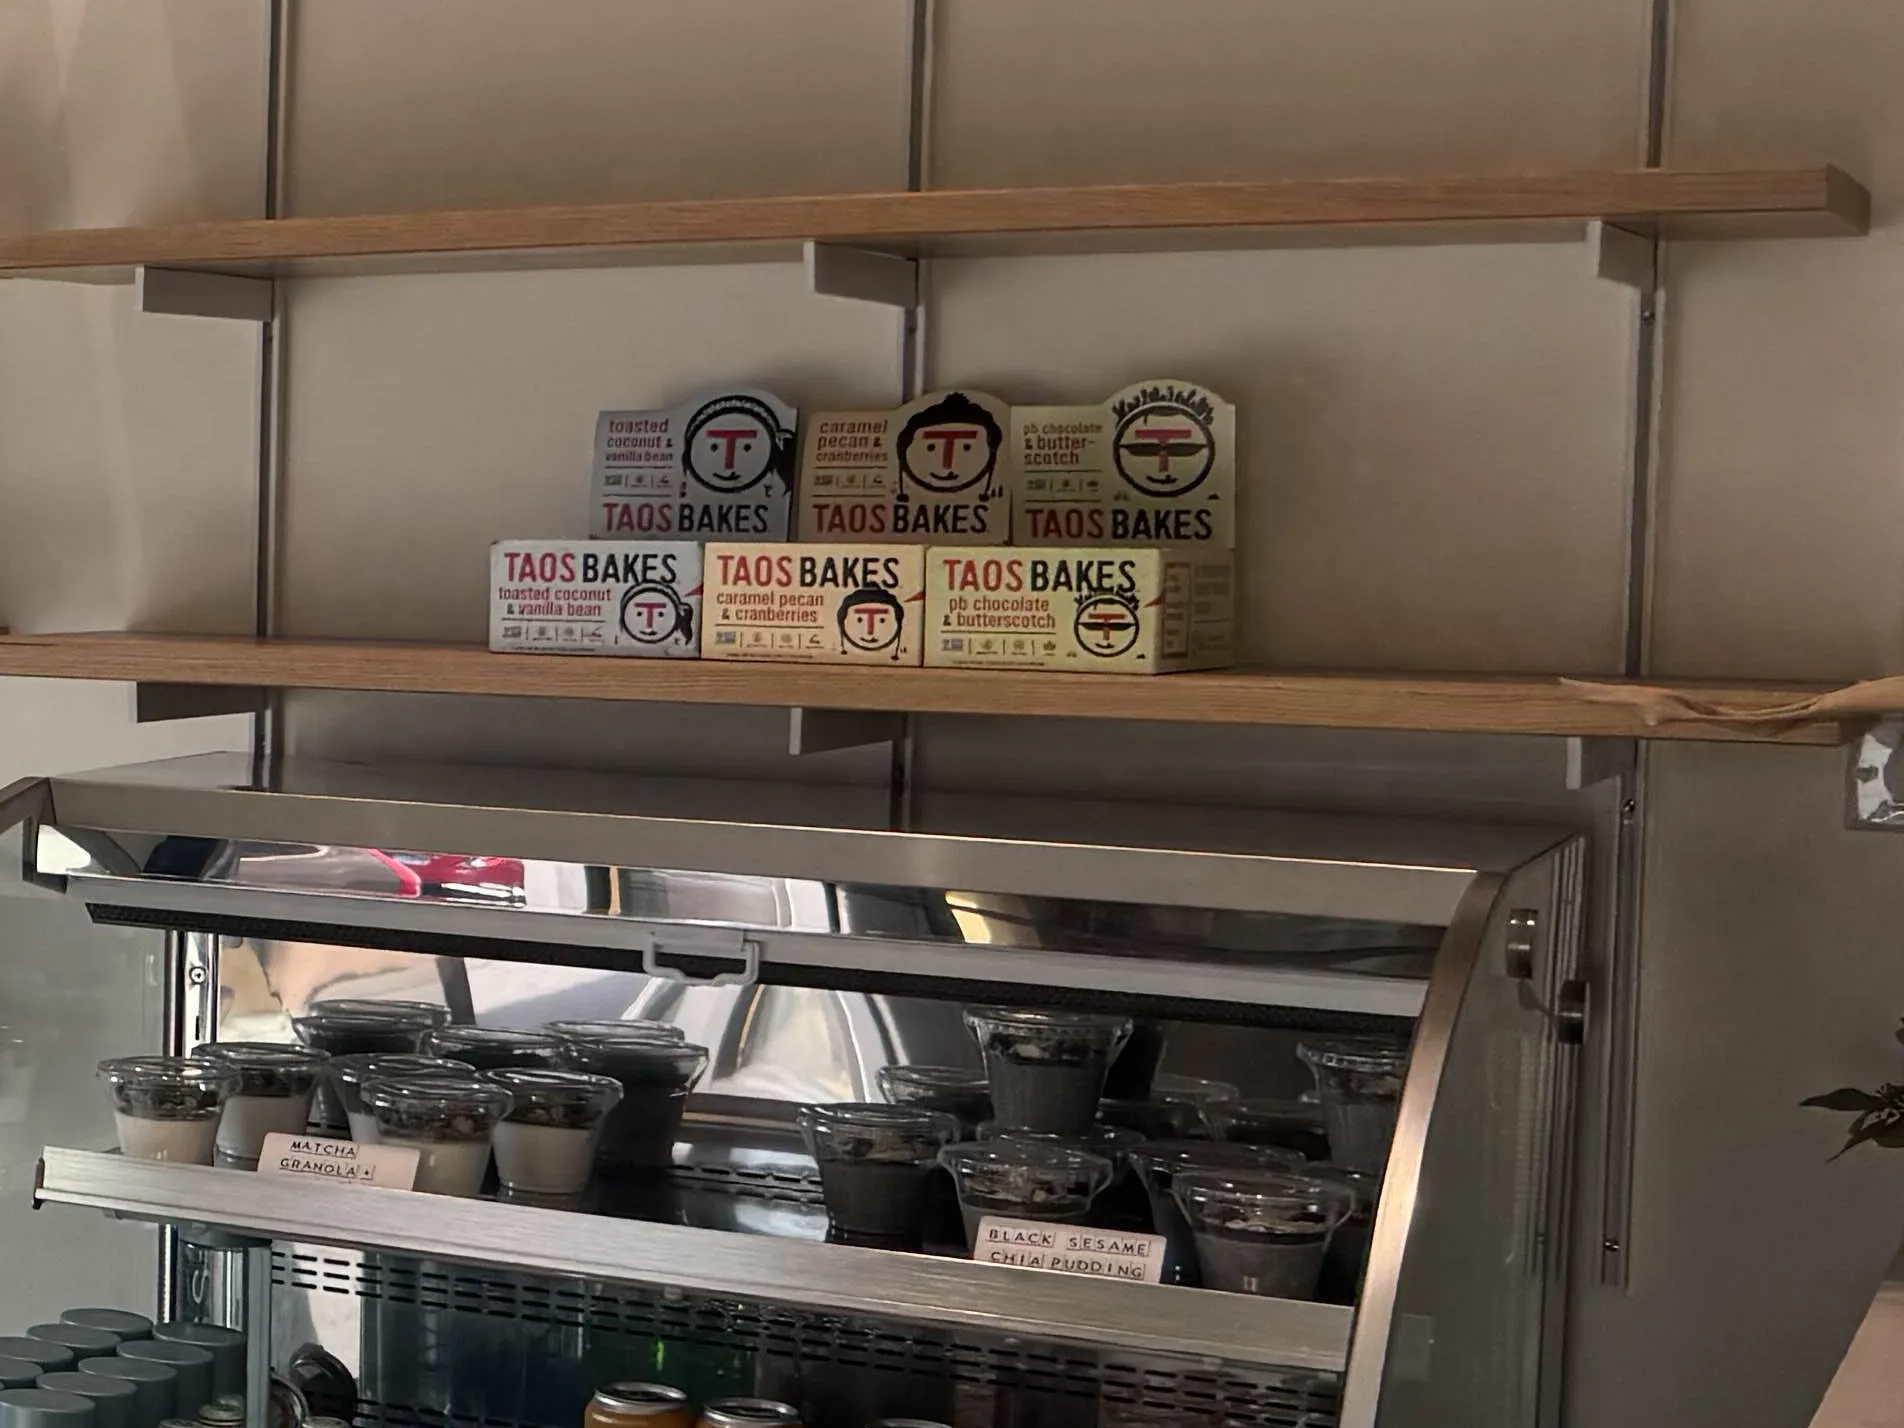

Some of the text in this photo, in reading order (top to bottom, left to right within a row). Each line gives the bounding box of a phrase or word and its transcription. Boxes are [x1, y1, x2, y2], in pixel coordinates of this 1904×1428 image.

[609, 418, 669, 434] toasted
[819, 419, 888, 434] caramel
[607, 437, 662, 449] coconut
[817, 436, 869, 451] pecan
[1037, 436, 1096, 451] butter-
[605, 450, 673, 462] vanilla bean
[815, 450, 888, 463] cranberries
[1023, 451, 1080, 466] scotch
[602, 503, 769, 533] TAOS BAKES
[812, 503, 989, 534] TAOS BAKES
[1025, 508, 1213, 540] TAOS BAKES
[504, 552, 678, 584] TAOS BAKES
[716, 555, 900, 589] TAOS BAKES
[943, 558, 1137, 594] TAOS BAKES
[498, 586, 612, 602] toasted coconut
[716, 590, 825, 609] caramel pecan
[518, 602, 563, 616] vanilla
[566, 603, 601, 617] bean
[948, 596, 1050, 614] pb chocolate
[721, 607, 818, 623] & cranberries
[942, 613, 1056, 630] & butterscotch
[292, 1141, 357, 1157] MATCHA
[280, 1158, 357, 1176] GRANOLA
[989, 1228, 1148, 1255] BLACK SESAME
[991, 1251, 1144, 1278] CHIA PUDDING
